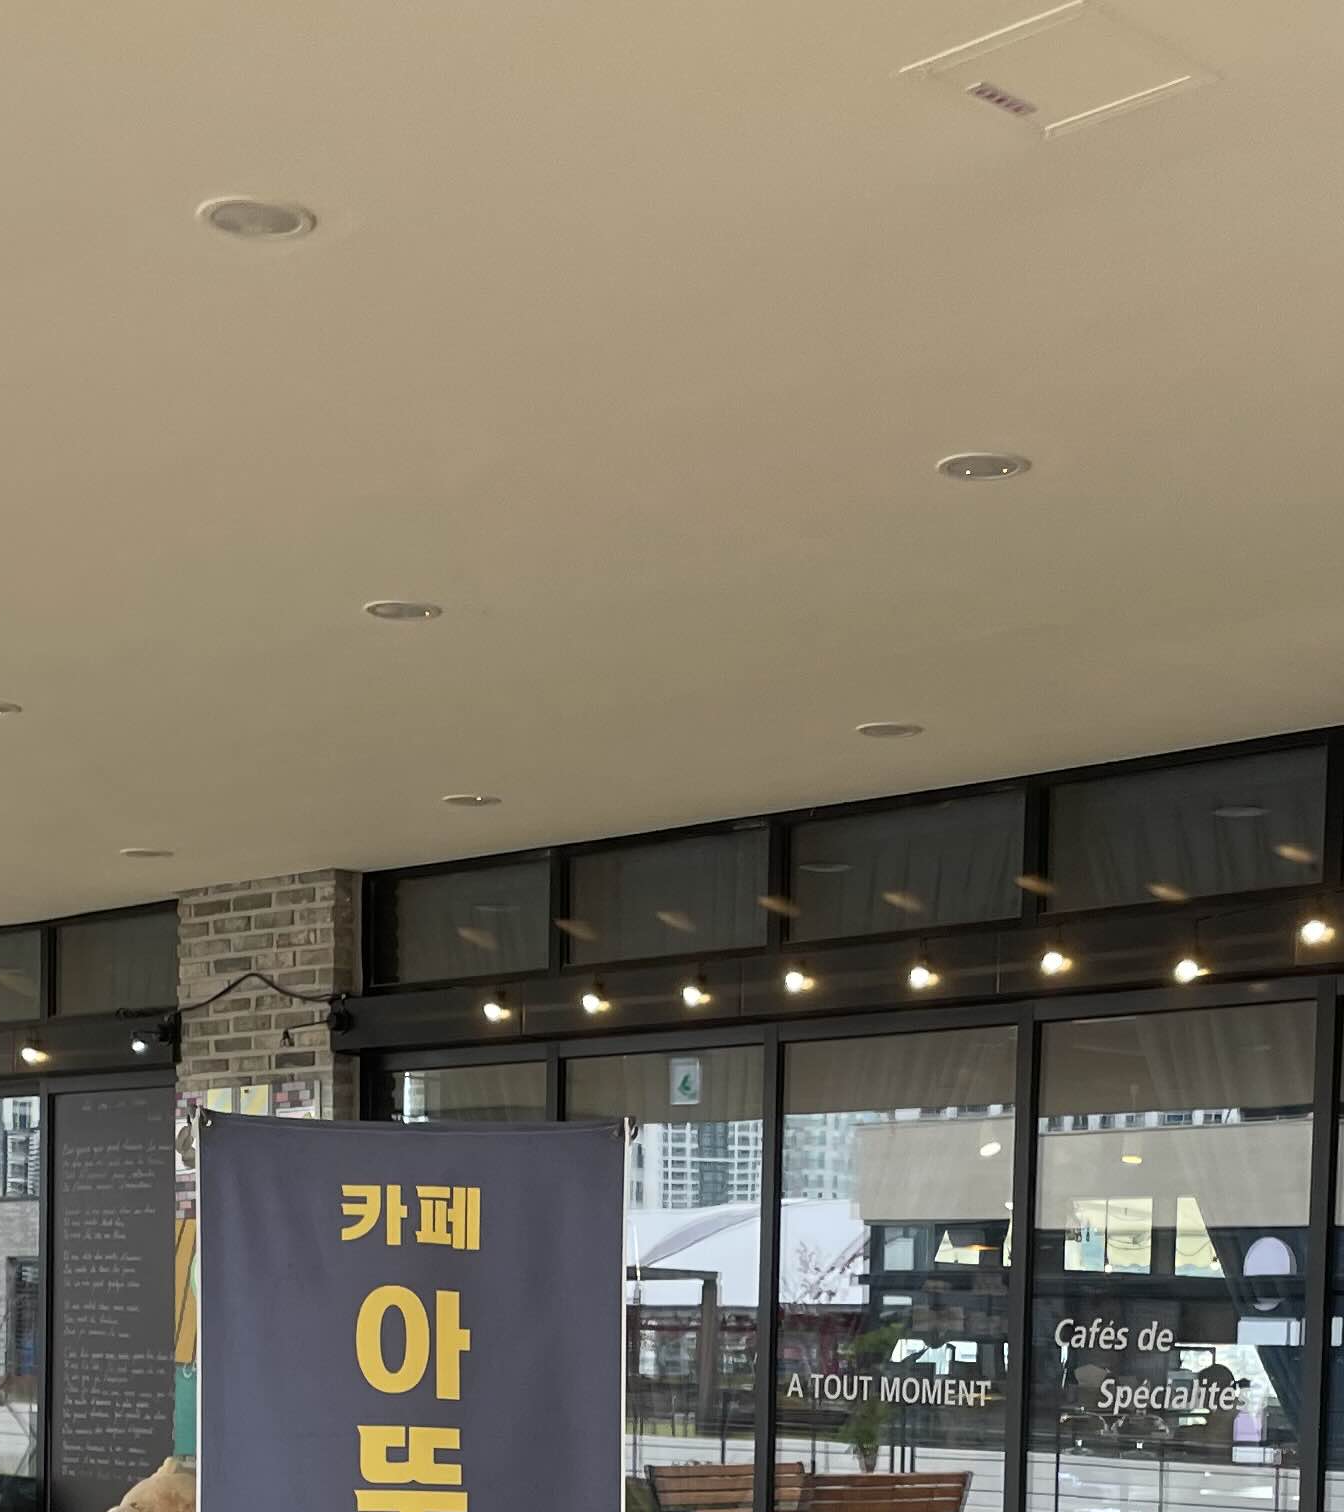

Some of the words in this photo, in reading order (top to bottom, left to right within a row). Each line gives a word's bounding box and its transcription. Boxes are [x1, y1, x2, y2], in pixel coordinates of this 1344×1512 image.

[340, 1184, 481, 1250] 카페
[1054, 1318, 1129, 1351] Cafés
[1137, 1321, 1175, 1353] de
[786, 1373, 804, 1398] A
[810, 1373, 873, 1401] TOUT
[879, 1376, 992, 1407] MOMENT
